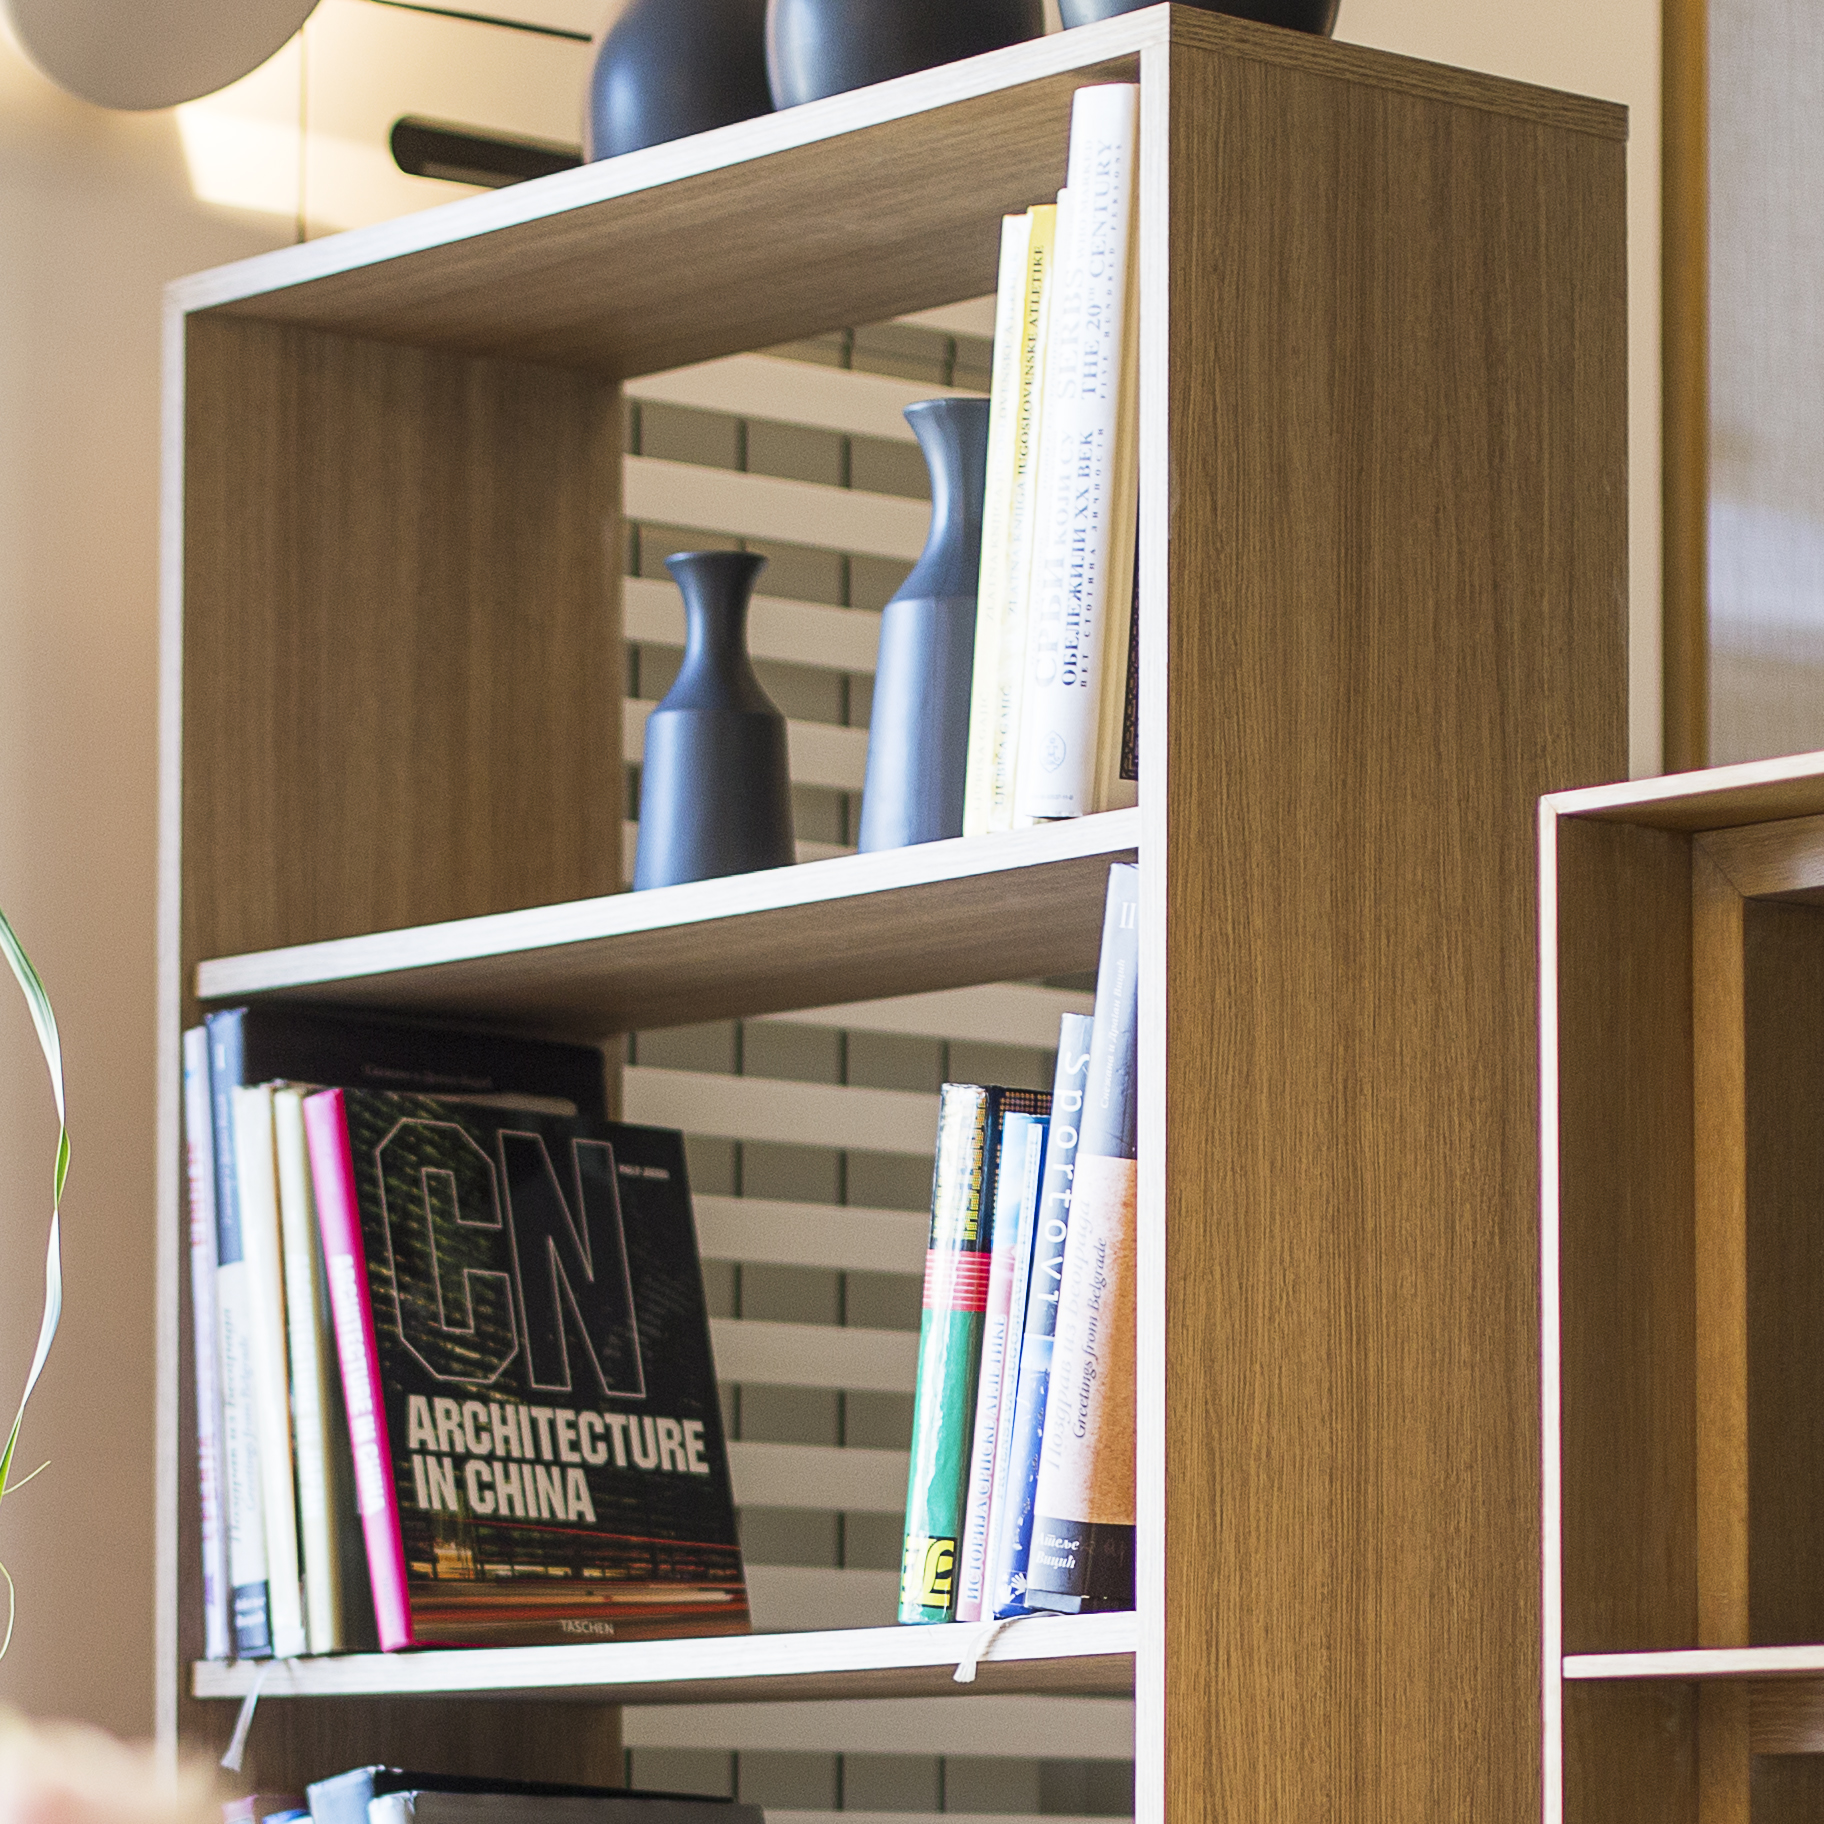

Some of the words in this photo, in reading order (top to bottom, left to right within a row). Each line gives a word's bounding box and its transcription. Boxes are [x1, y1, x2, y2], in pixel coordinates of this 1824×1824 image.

[1090, 139, 1113, 278] CENTURY
[1110, 144, 1122, 231] PERSONS
[1027, 246, 1045, 329] ATLETIKE
[1104, 248, 1115, 338] HUNDRED
[1058, 267, 1083, 400] SERBS
[1082, 340, 1100, 400] THE
[1015, 333, 1039, 477] JUGOSLOVENSKE
[1100, 355, 1109, 399] FIVE
[1010, 480, 1027, 543] KNJIGA
[1006, 549, 1023, 615] ZLATNA
[1034, 556, 1065, 688] СРБИ
[1054, 473, 1073, 545] КОЈИ
[1061, 528, 1087, 687] ОБЕЛЕЖИЛИ
[1077, 430, 1094, 478] ВЕК
[1080, 653, 1090, 688] ПЕТ
[375, 1117, 646, 1398] CN
[1086, 1237, 1108, 1311] Belgrade
[330, 1253, 373, 1415] ARCHITECTURE
[1079, 1315, 1098, 1359] from
[354, 1416, 376, 1442] IN
[405, 1394, 710, 1475] ARCHITECTURE
[1072, 1361, 1097, 1441] Greetings
[358, 1443, 385, 1519] CHINA
[412, 1456, 462, 1512] IN
[463, 1460, 596, 1523] CHINA
[966, 1498, 988, 1601] ИСТОРИЈА
[977, 1419, 997, 1497] СРПСКЕ
[560, 1619, 615, 1635] TASCHEN
